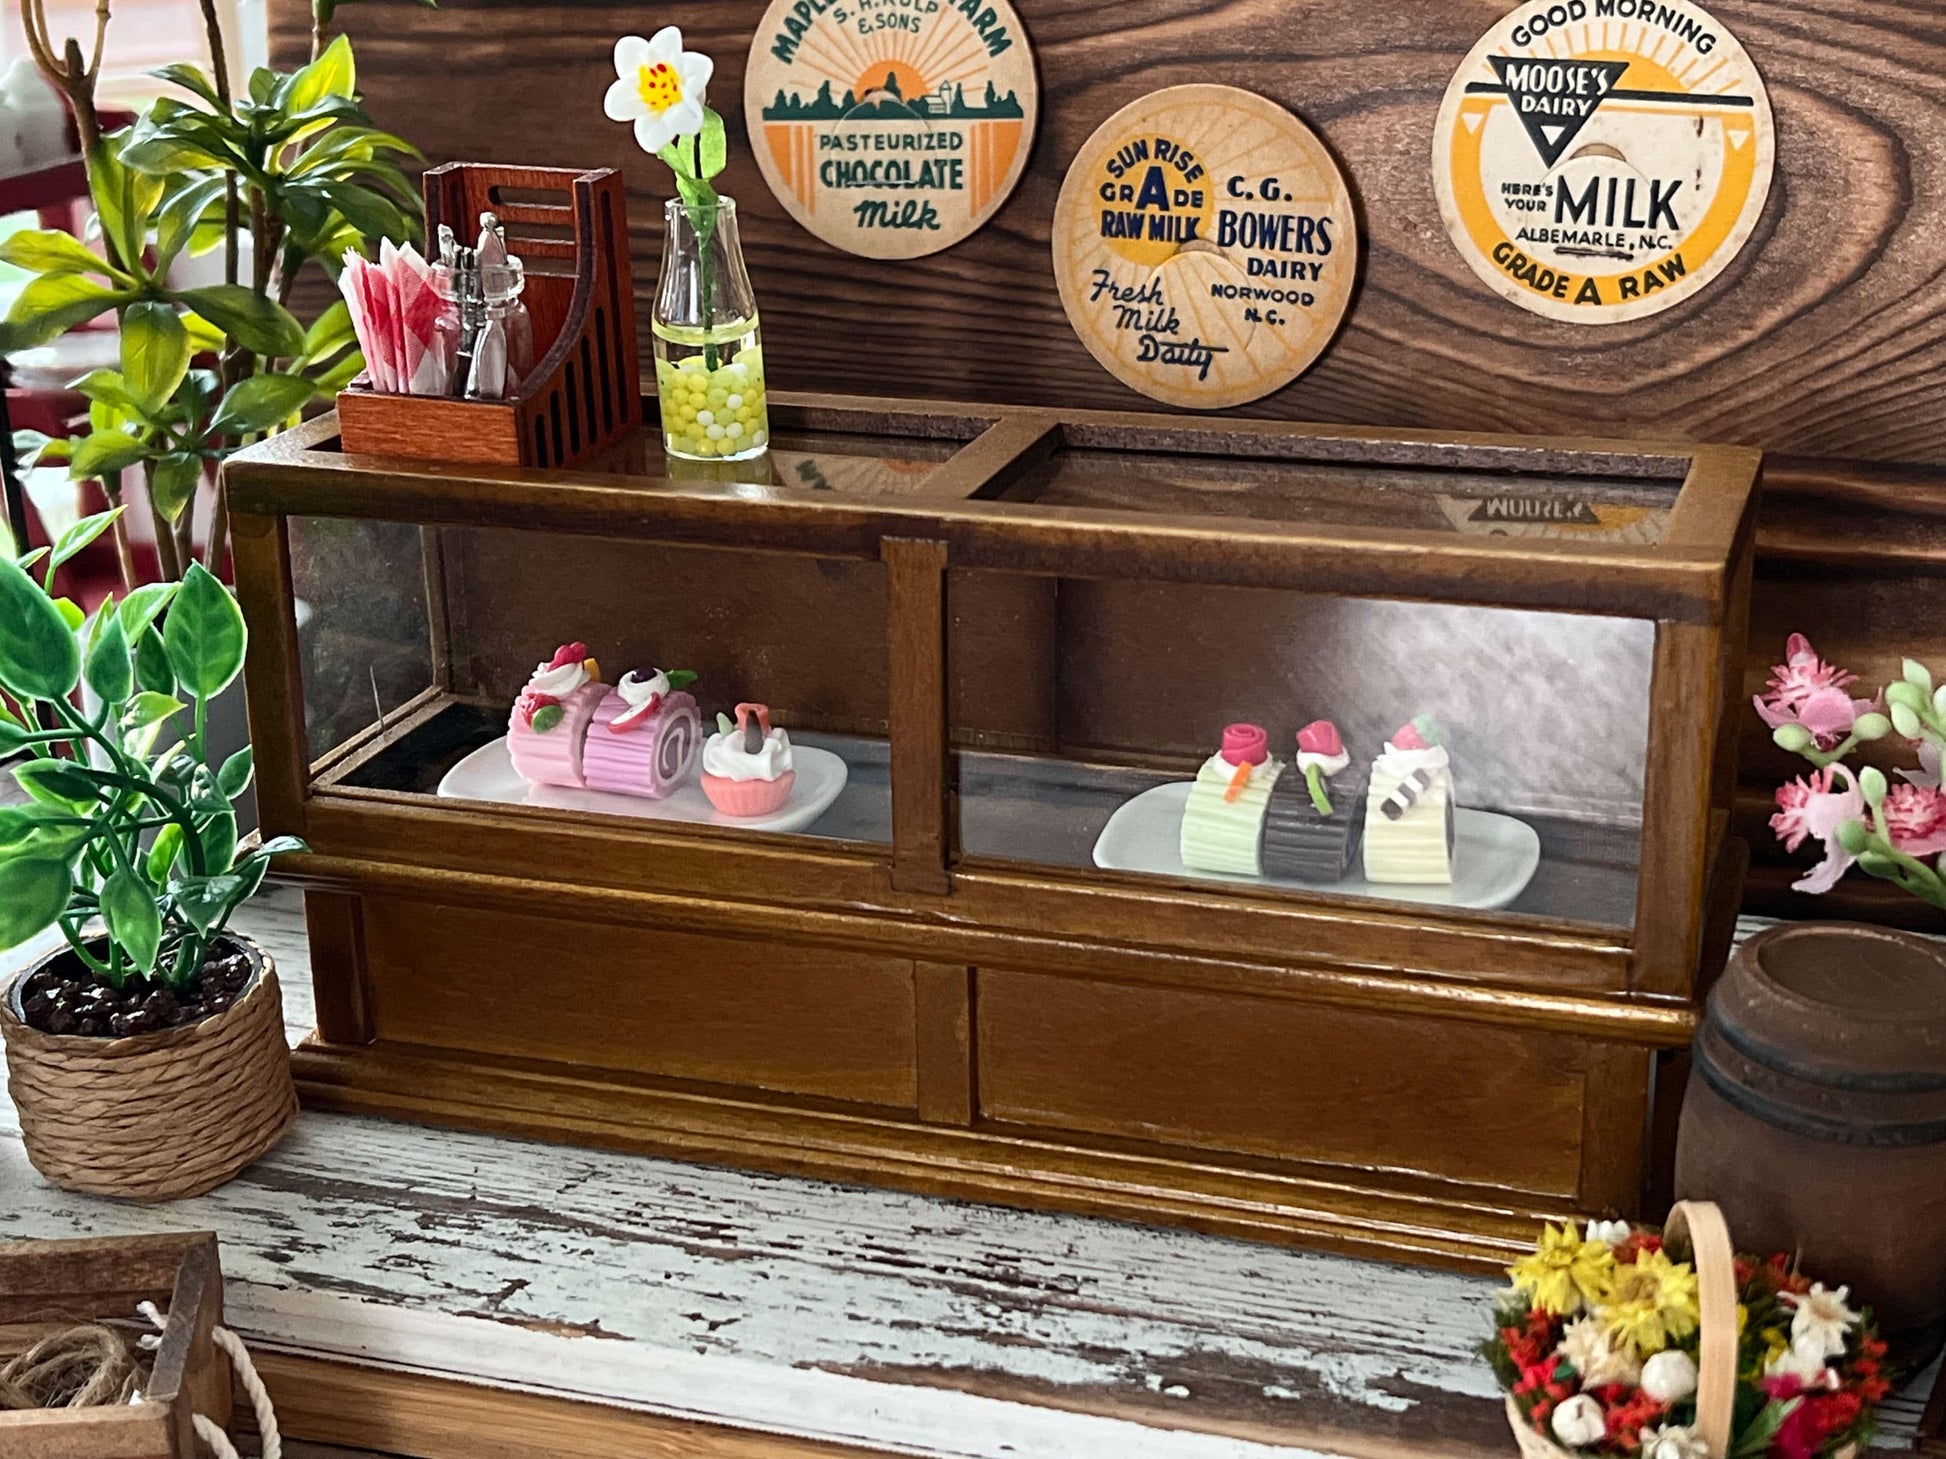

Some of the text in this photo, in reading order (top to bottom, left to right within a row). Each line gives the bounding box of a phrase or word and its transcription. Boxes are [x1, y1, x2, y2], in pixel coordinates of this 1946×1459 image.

[770, 0, 1013, 65] MAPL ARM
[875, 13, 921, 34] SONS
[1511, 0, 1716, 54] GOOD MORNING
[1505, 63, 1609, 96] MOOSE'S
[1521, 95, 1592, 117] DAIRY
[819, 131, 963, 151] PASTEURIZED
[820, 158, 963, 190] CHOCOLATE
[1106, 138, 1204, 184] SUN RISE
[1501, 182, 1554, 197] HERE'S
[1504, 197, 1547, 212] YOUR
[1554, 174, 1683, 231] MILK
[853, 199, 941, 230] Milk
[1100, 210, 1200, 243] RAW MILK
[1217, 209, 1334, 256] BOWERS
[1246, 256, 1324, 282] DAIRY
[1492, 242, 1687, 305] GRADE A RAW
[1090, 269, 1164, 306] Fresh
[1211, 283, 1315, 307] NORWOOD
[1112, 304, 1181, 335] Milk
